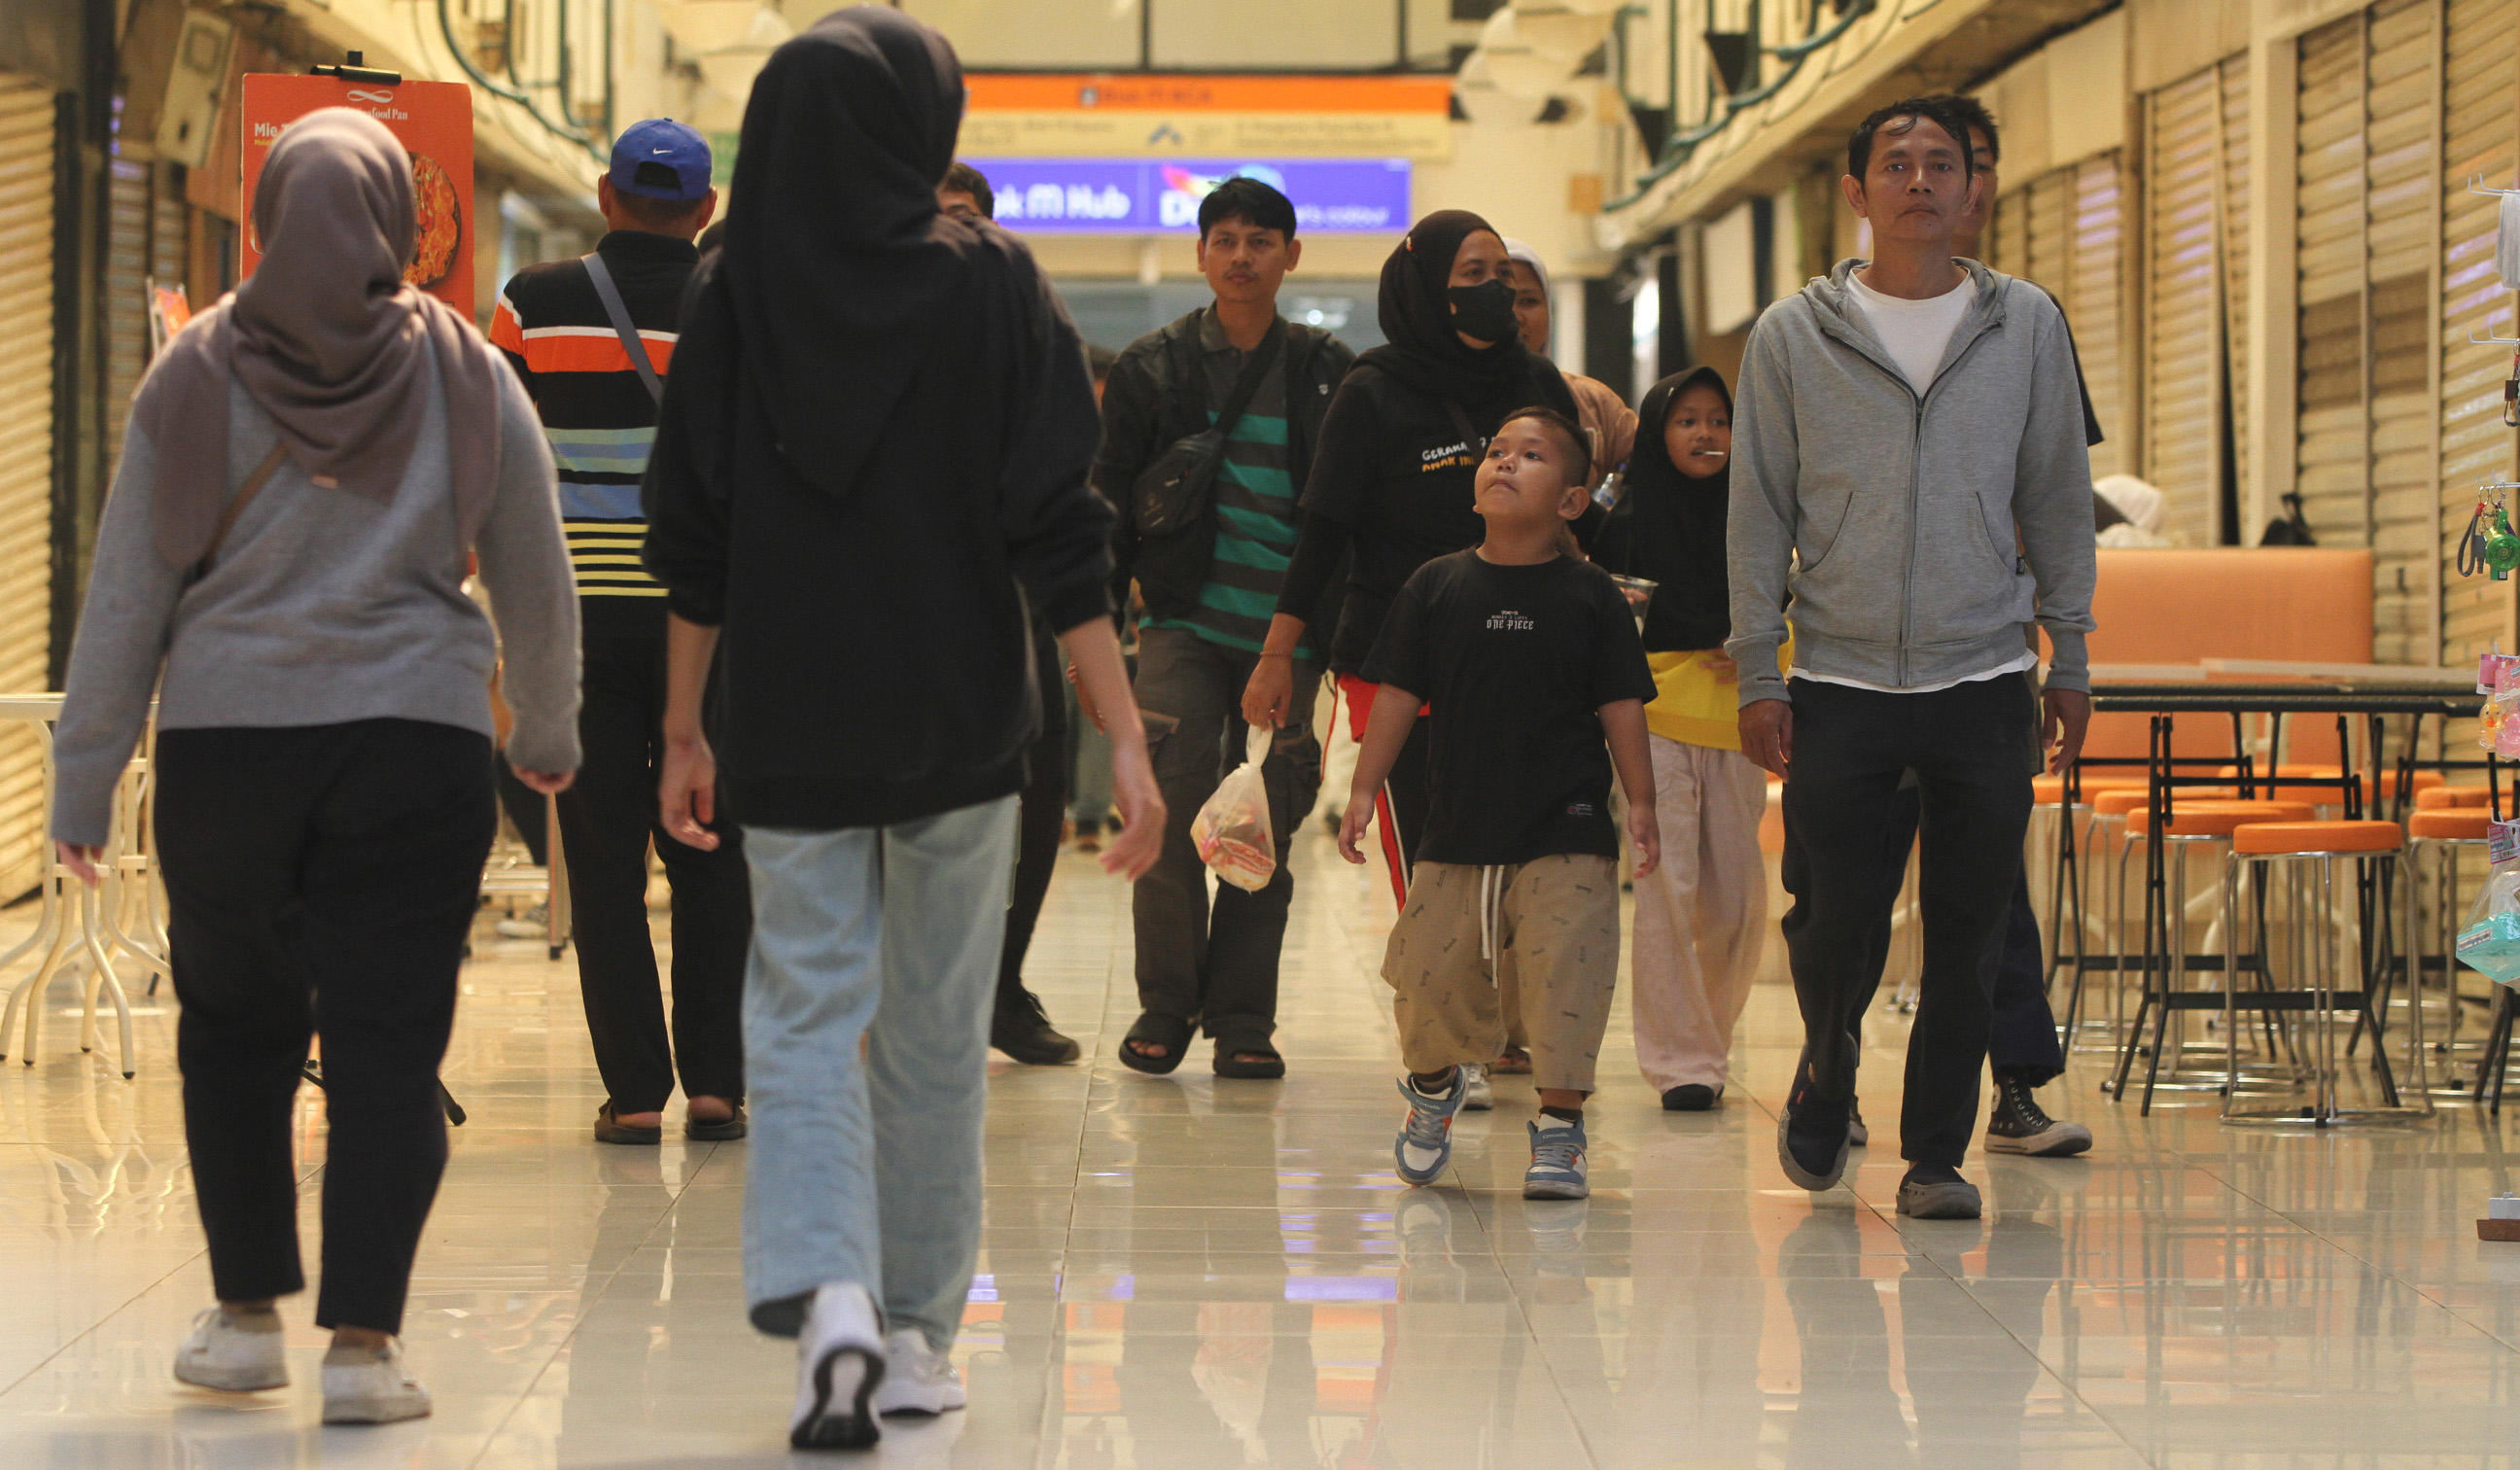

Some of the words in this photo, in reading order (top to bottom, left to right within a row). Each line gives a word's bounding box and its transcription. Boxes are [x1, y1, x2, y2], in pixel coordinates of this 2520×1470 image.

[392, 108, 408, 120] Pan
[254, 122, 278, 137] Mie
[1067, 183, 1131, 220] Hub
[1421, 441, 1469, 461] GERAKA
[1487, 618, 1504, 630] ONE
[1507, 619, 1534, 630] PIECE
